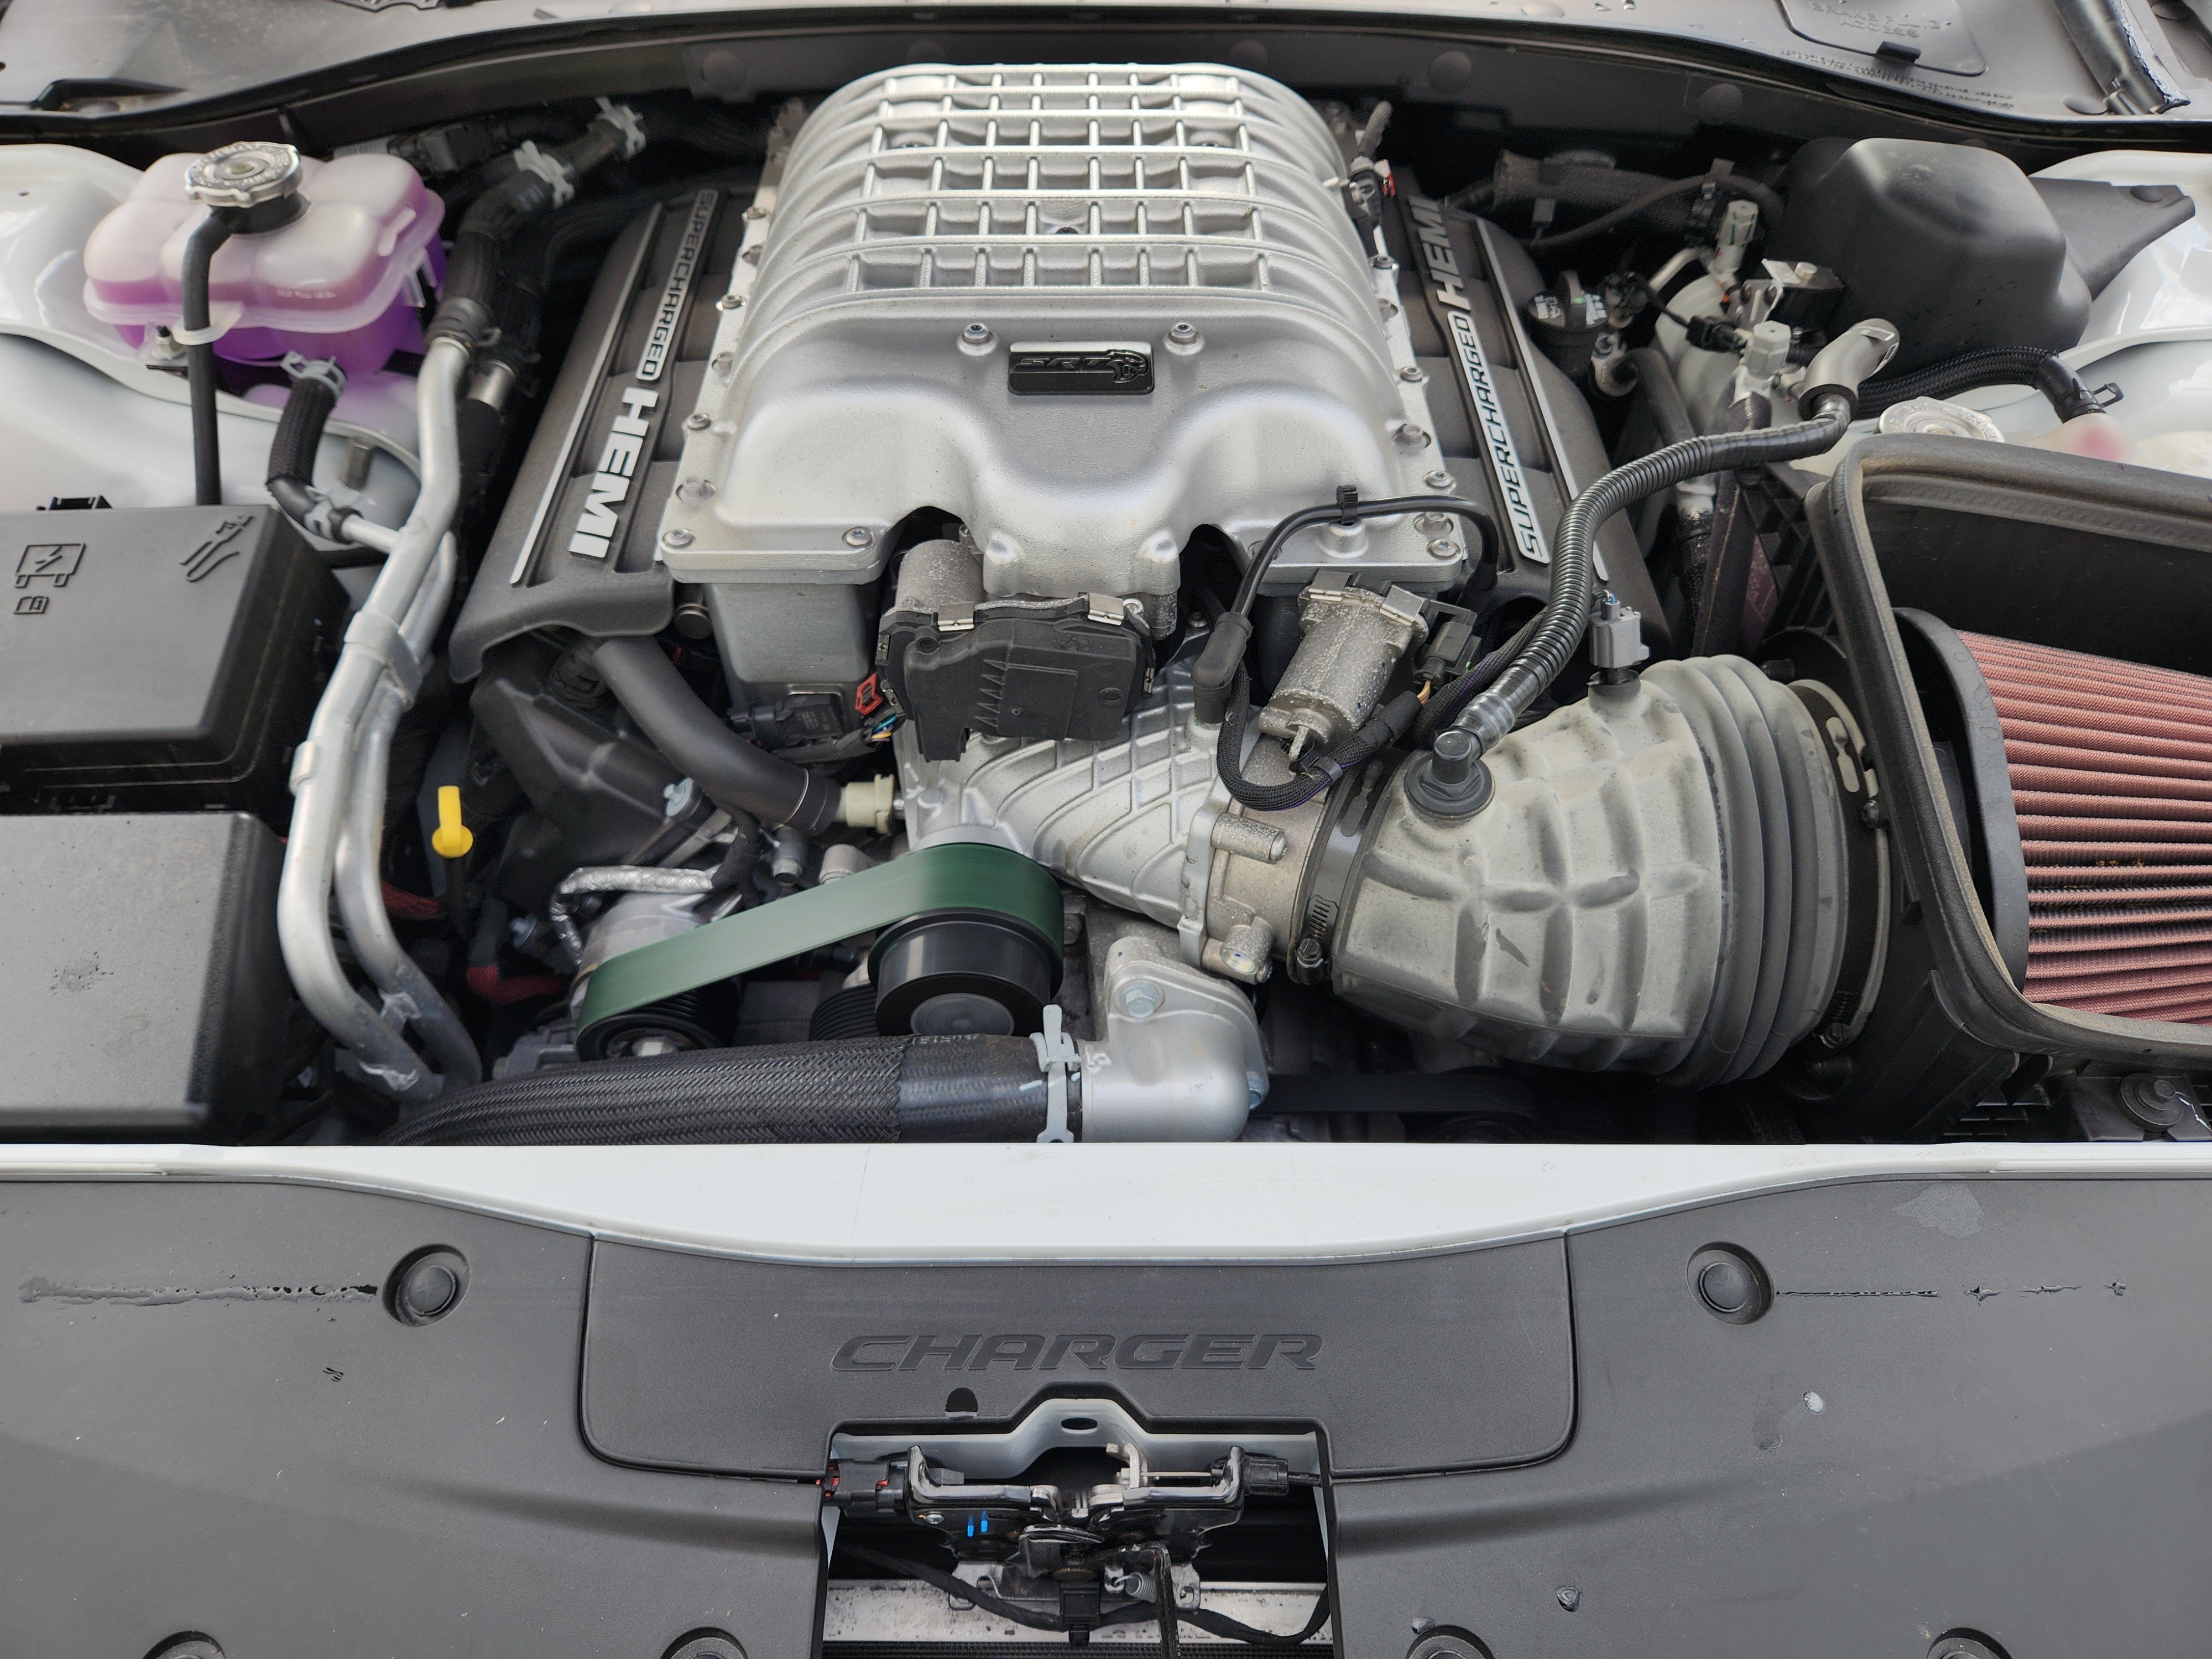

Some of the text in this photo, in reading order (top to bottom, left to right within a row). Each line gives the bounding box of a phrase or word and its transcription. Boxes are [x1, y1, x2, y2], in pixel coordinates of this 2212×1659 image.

[1812, 2, 1879, 22] BRAKE
[1840, 19, 1919, 38] ACCESS
[568, 192, 714, 558] SUPERCHARGED HEMI
[1014, 357, 1112, 371] SRT
[1408, 195, 1544, 559] SUPERCHARGED HEMI
[831, 1333, 1324, 1370] CHARGER
